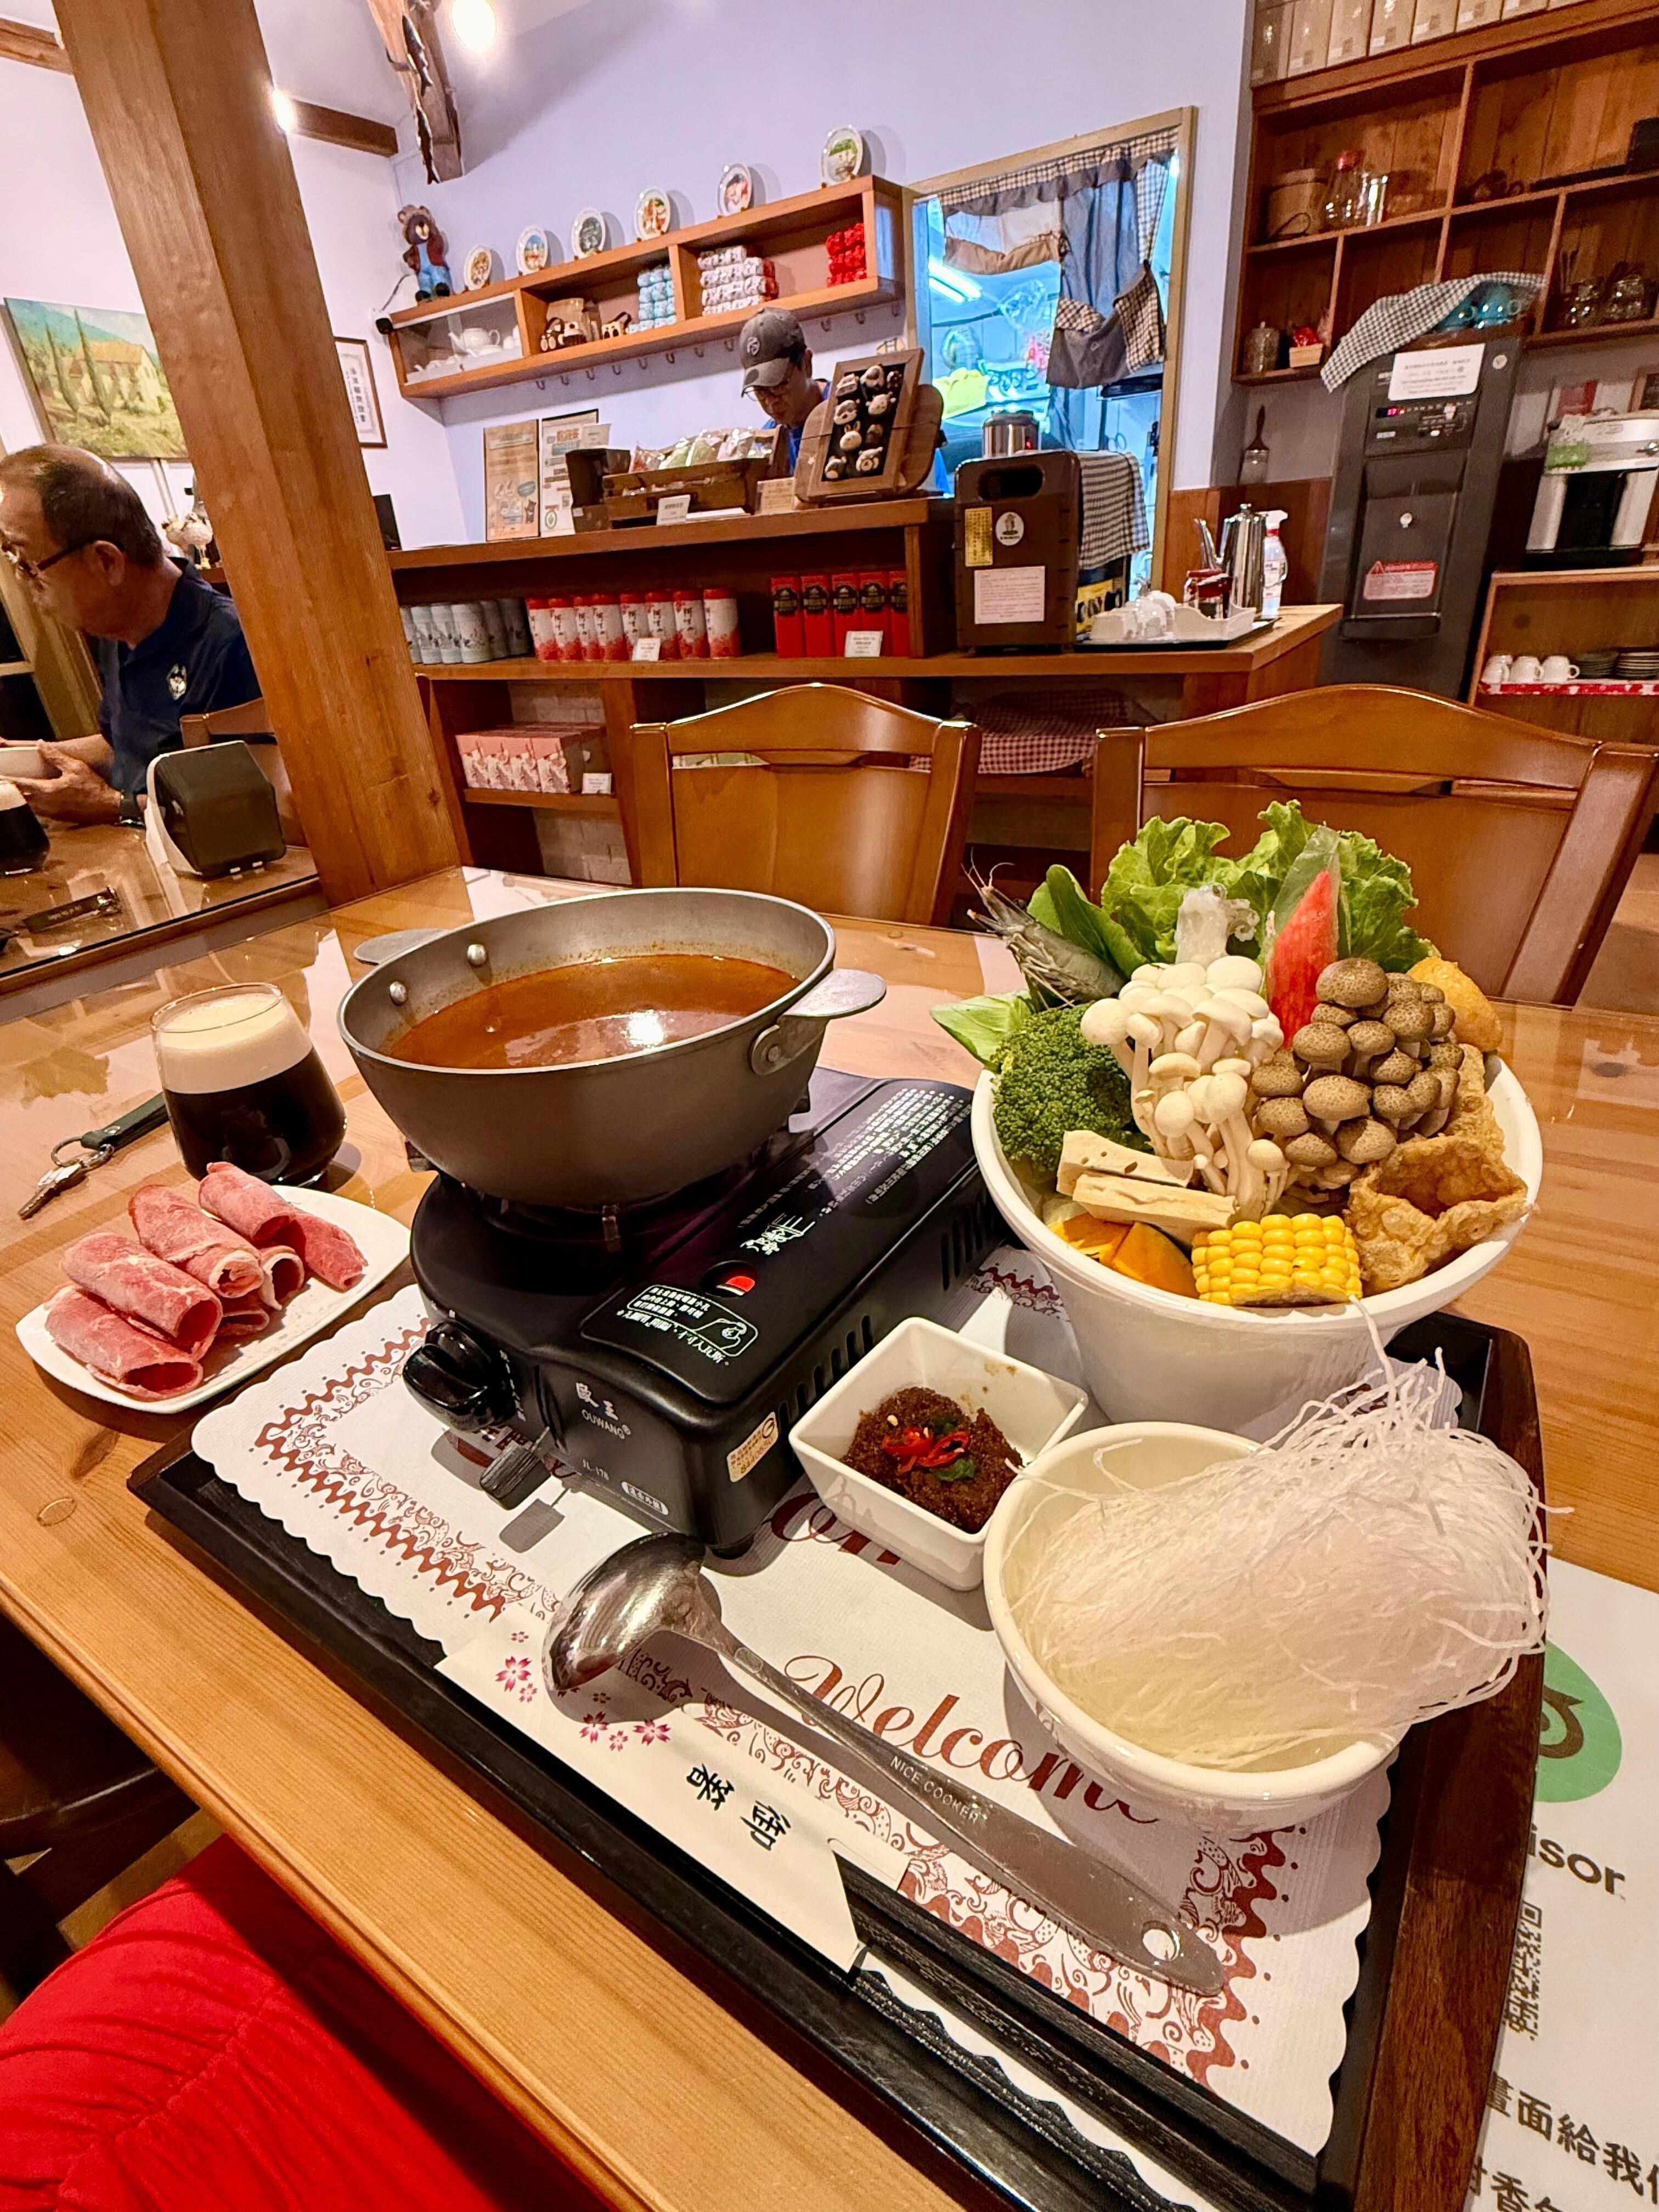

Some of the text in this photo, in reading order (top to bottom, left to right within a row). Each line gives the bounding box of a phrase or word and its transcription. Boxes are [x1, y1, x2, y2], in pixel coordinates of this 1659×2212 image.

[575, 1381, 619, 1421] 歐王
[784, 1655, 1159, 1824] Welcom
[686, 1763, 792, 1852] 御箸
[890, 1756, 980, 1825] NICE COOKER
[1527, 1822, 1626, 1895] isor
